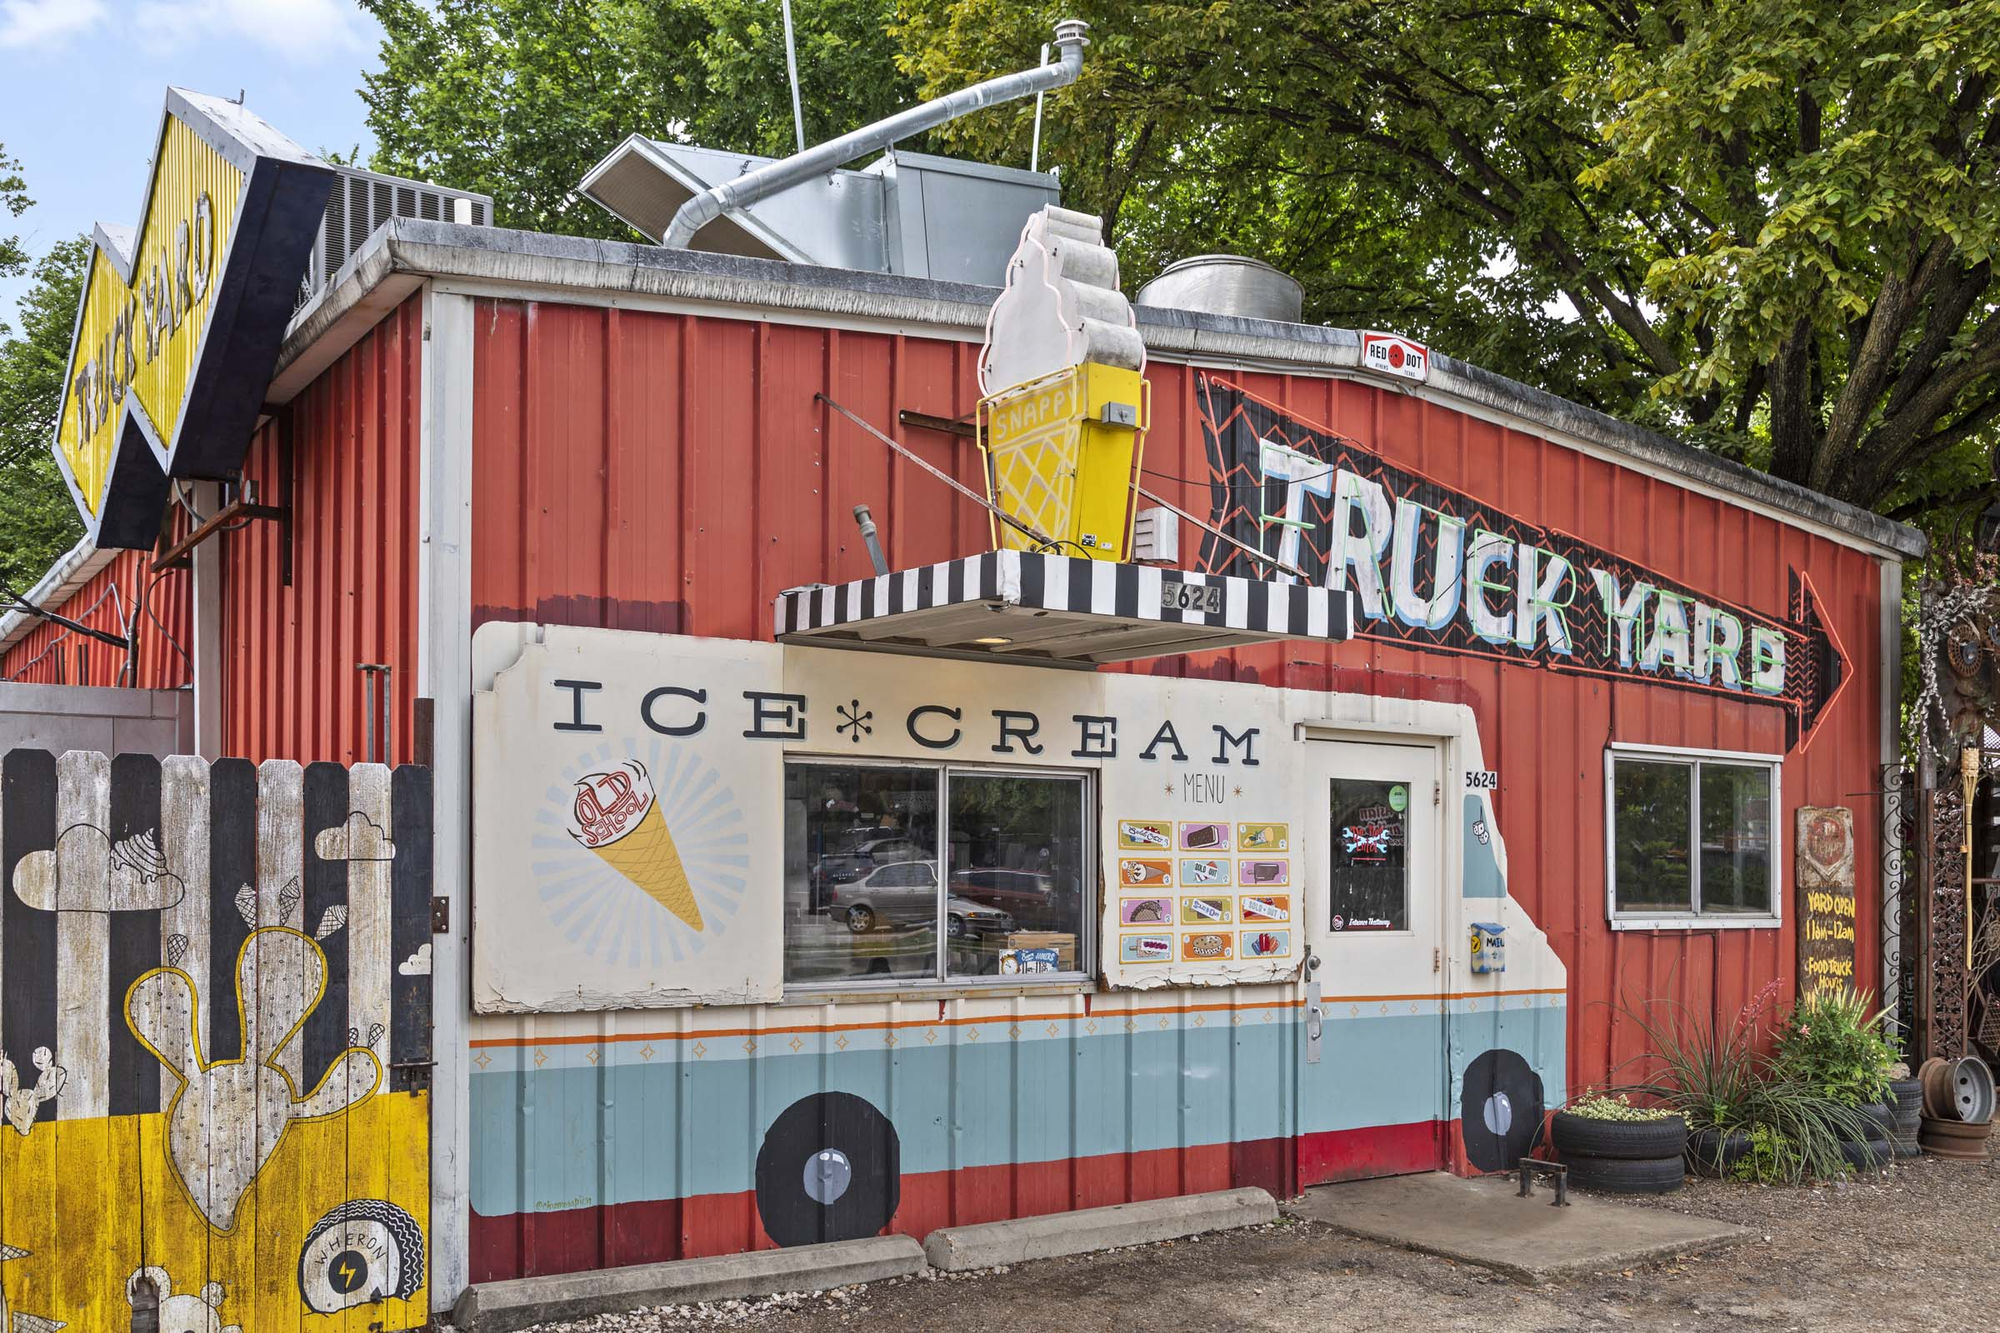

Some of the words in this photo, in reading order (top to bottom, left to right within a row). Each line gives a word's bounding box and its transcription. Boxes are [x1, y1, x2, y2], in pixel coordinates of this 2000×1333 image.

[75, 292, 136, 451] TRUCK
[141, 191, 212, 364] YARD
[1370, 344, 1387, 360] RED
[1406, 353, 1422, 369] DOT
[995, 384, 1080, 440] SNAPPY
[1259, 437, 1573, 656] TRUCK
[1589, 567, 1785, 696] YARD
[1162, 582, 1219, 612] 5624
[553, 679, 807, 738] ICE
[906, 704, 1262, 766] CREAM
[1183, 773, 1225, 804] MENU
[1466, 771, 1497, 788] 5624
[578, 771, 631, 824] OLD
[581, 790, 649, 845] SCHOOL
[1807, 892, 1833, 914] YARD
[1834, 896, 1856, 918] OPEN
[1486, 937, 1505, 948] MAIL
[1808, 957, 1829, 975] FOOD
[1829, 958, 1853, 976] TRUCK
[315, 1233, 387, 1265] WHERON
